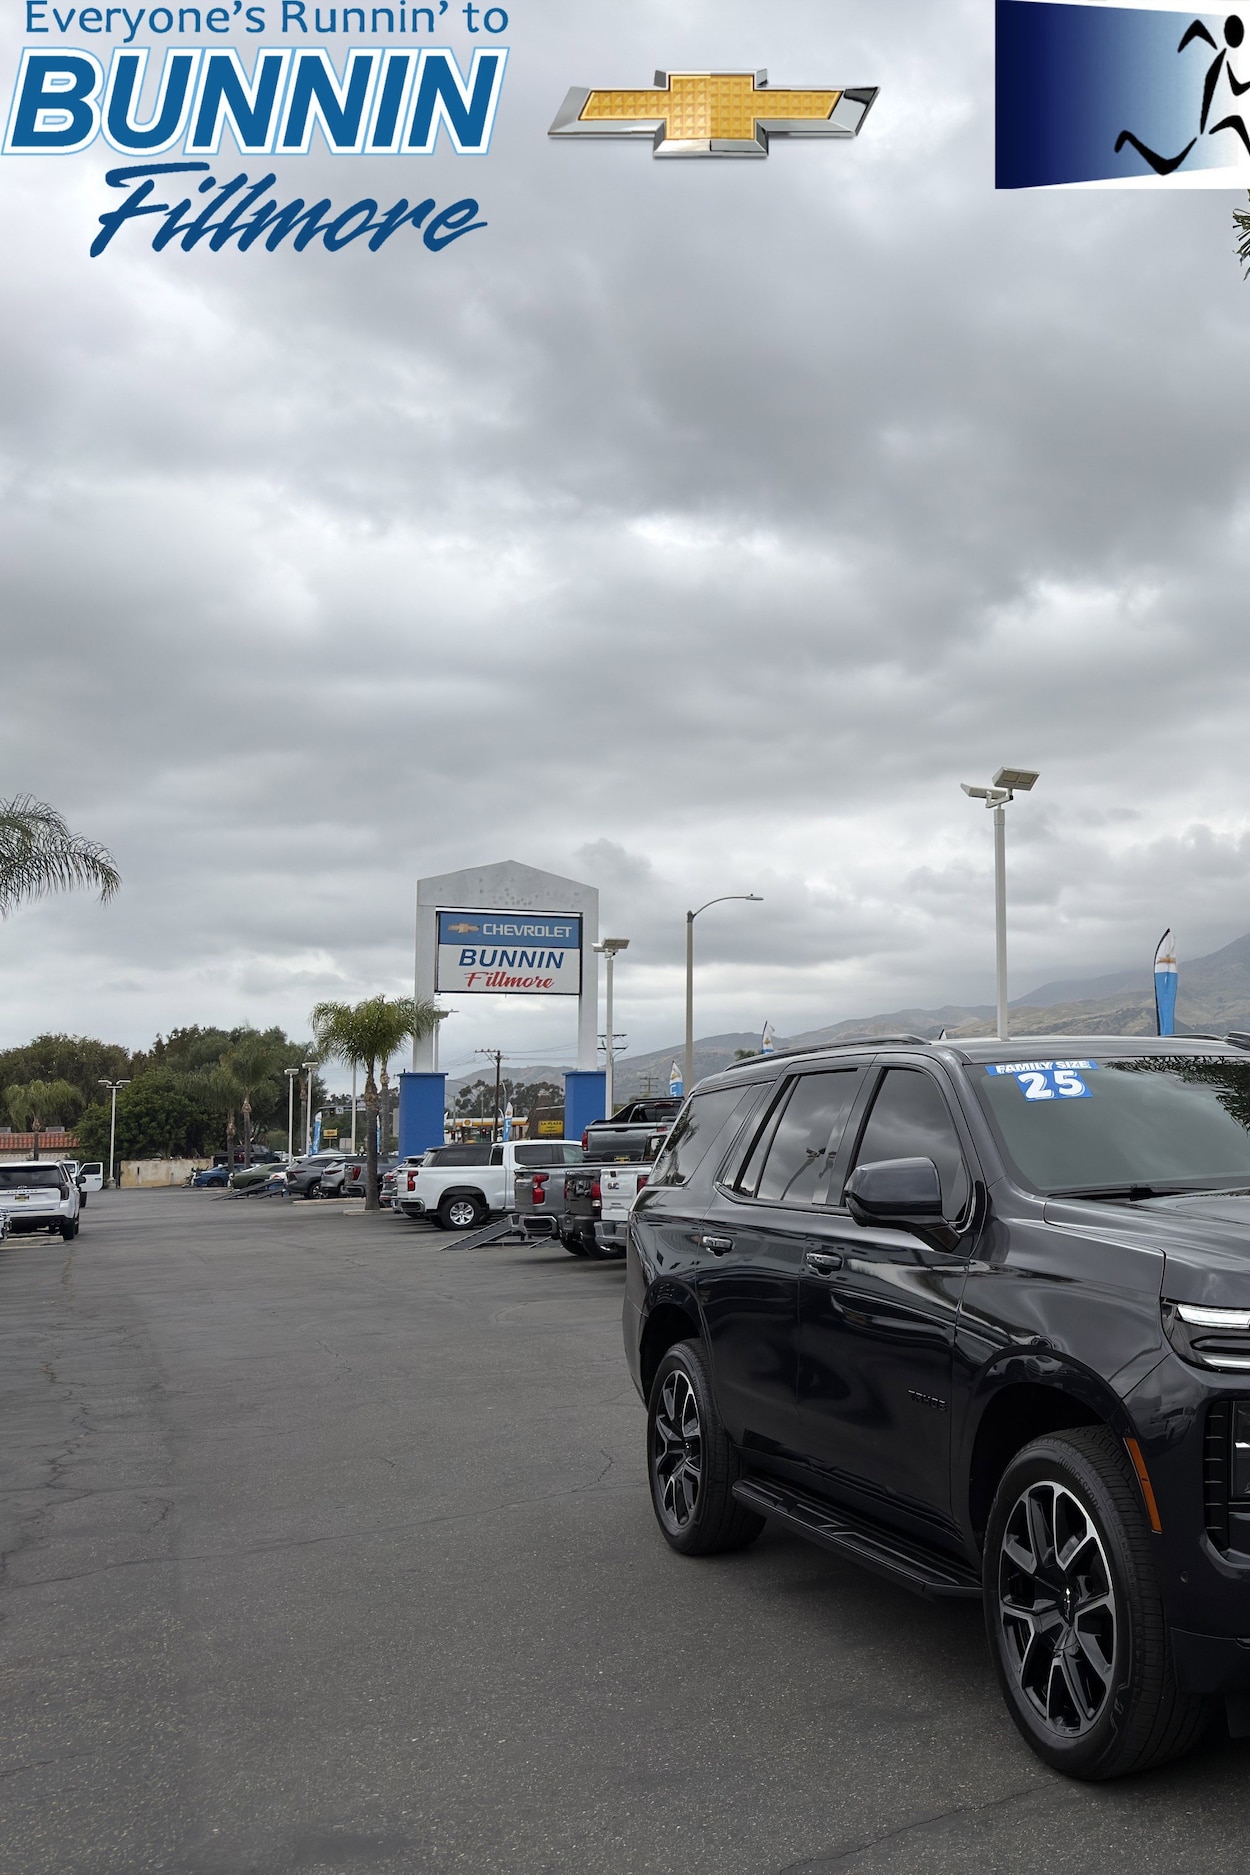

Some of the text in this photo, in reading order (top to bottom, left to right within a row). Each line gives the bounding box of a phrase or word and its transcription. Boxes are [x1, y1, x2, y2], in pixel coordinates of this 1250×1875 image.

[483, 923, 573, 938] CHEVROLET
[458, 948, 565, 969] BUNNIN
[463, 971, 556, 989] Fillmore
[995, 1060, 1092, 1075] FAMILY SIZE
[1017, 1070, 1086, 1100] 25
